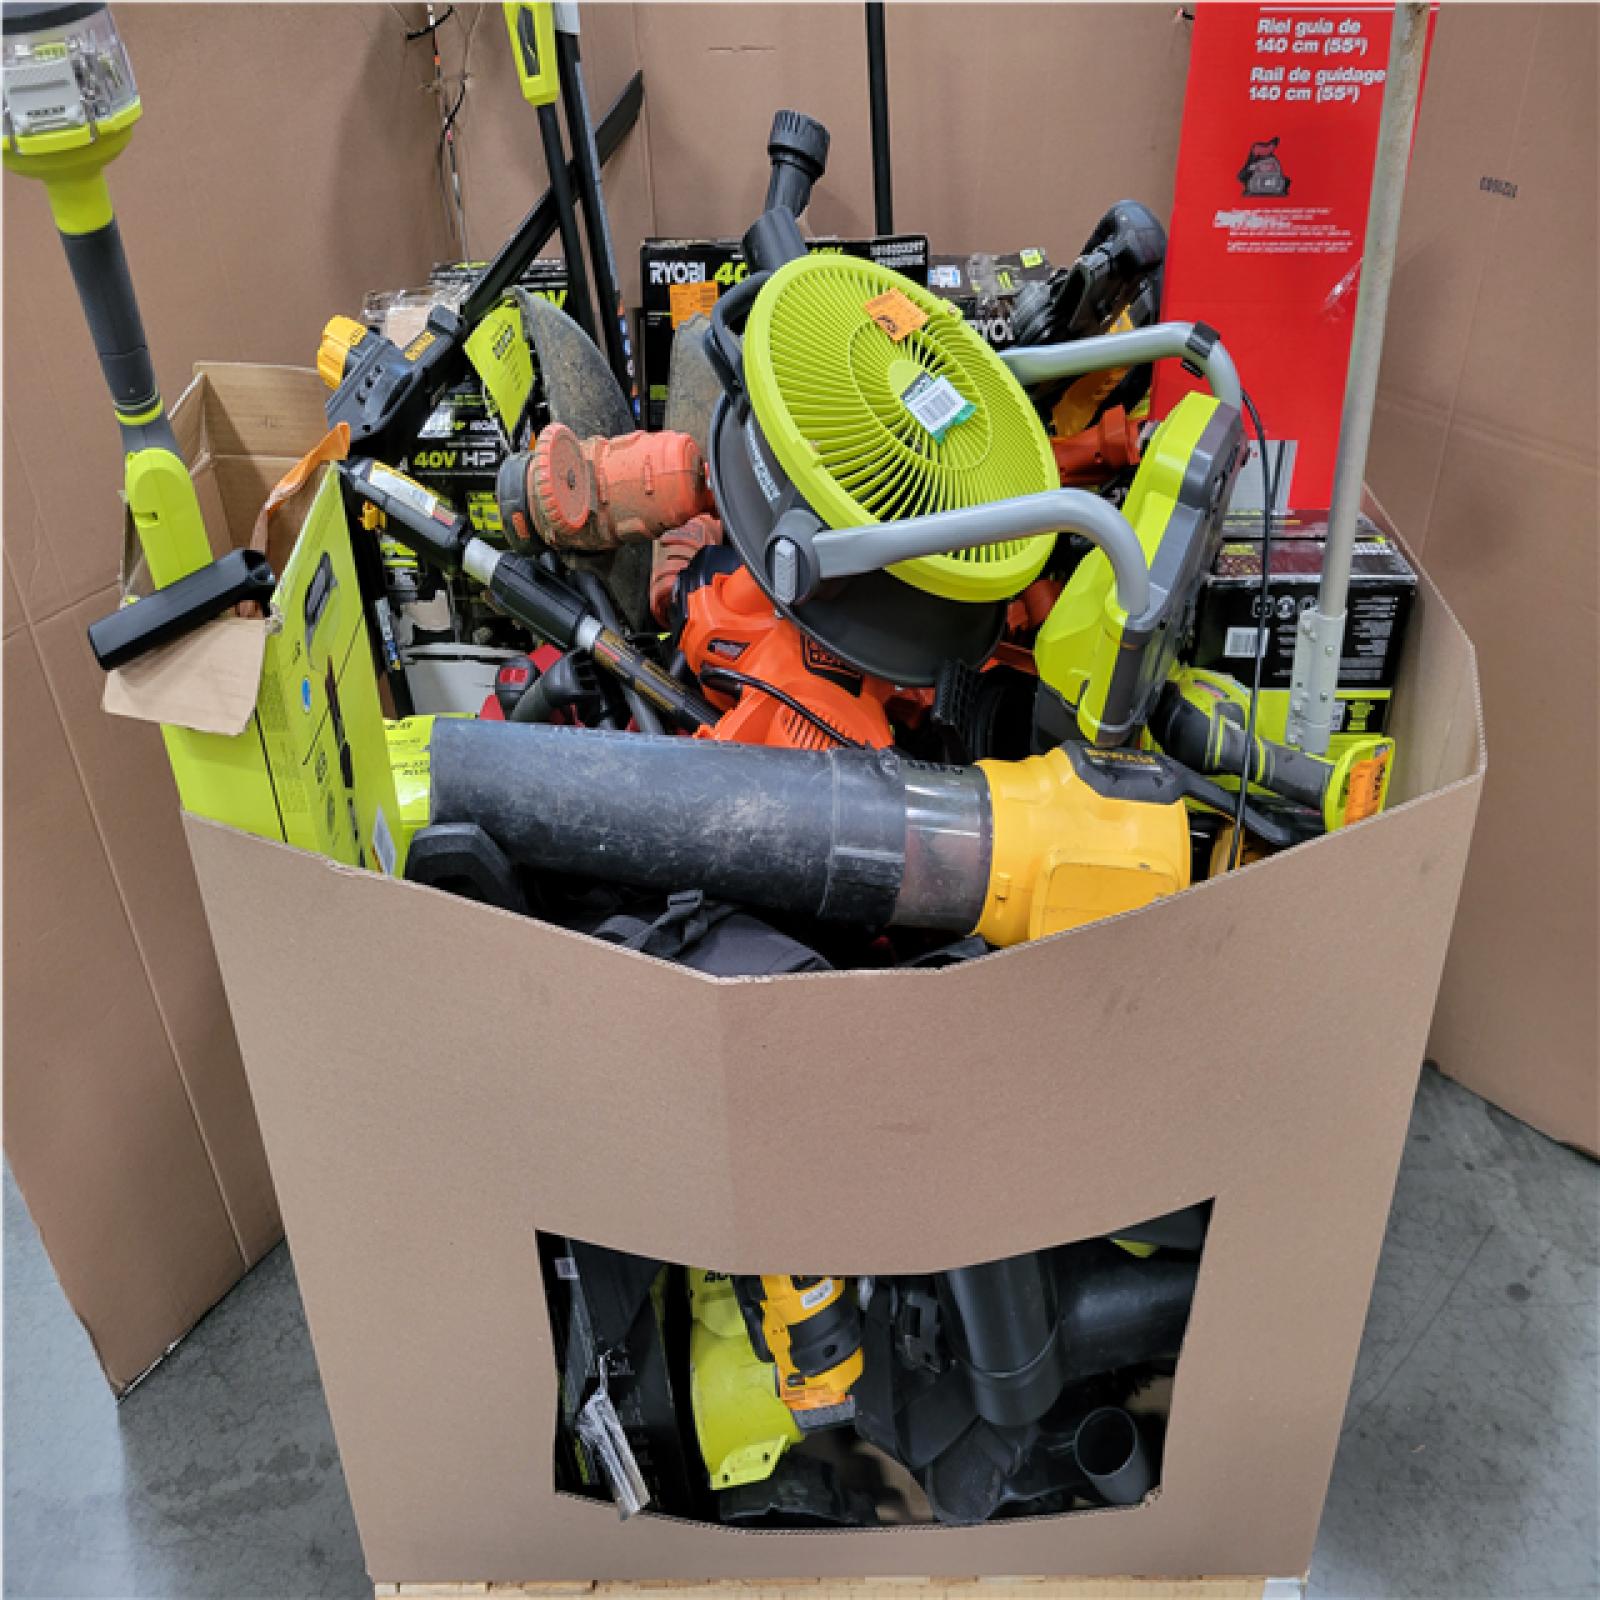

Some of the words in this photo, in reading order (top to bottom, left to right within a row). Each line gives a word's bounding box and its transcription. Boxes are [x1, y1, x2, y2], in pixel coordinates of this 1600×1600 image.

[1257, 17, 1291, 33] Riel
[1338, 17, 1361, 34] de
[1255, 37, 1288, 53] 140
[1292, 40, 1319, 53] cm
[1251, 67, 1285, 82] Rail
[1288, 67, 1311, 83] de
[1315, 67, 1386, 85] guidage
[1249, 85, 1281, 101] 140
[1285, 88, 1312, 101] cm
[649, 261, 706, 284] RYOBI
[415, 451, 457, 467] 40V
[461, 451, 496, 466] HP
